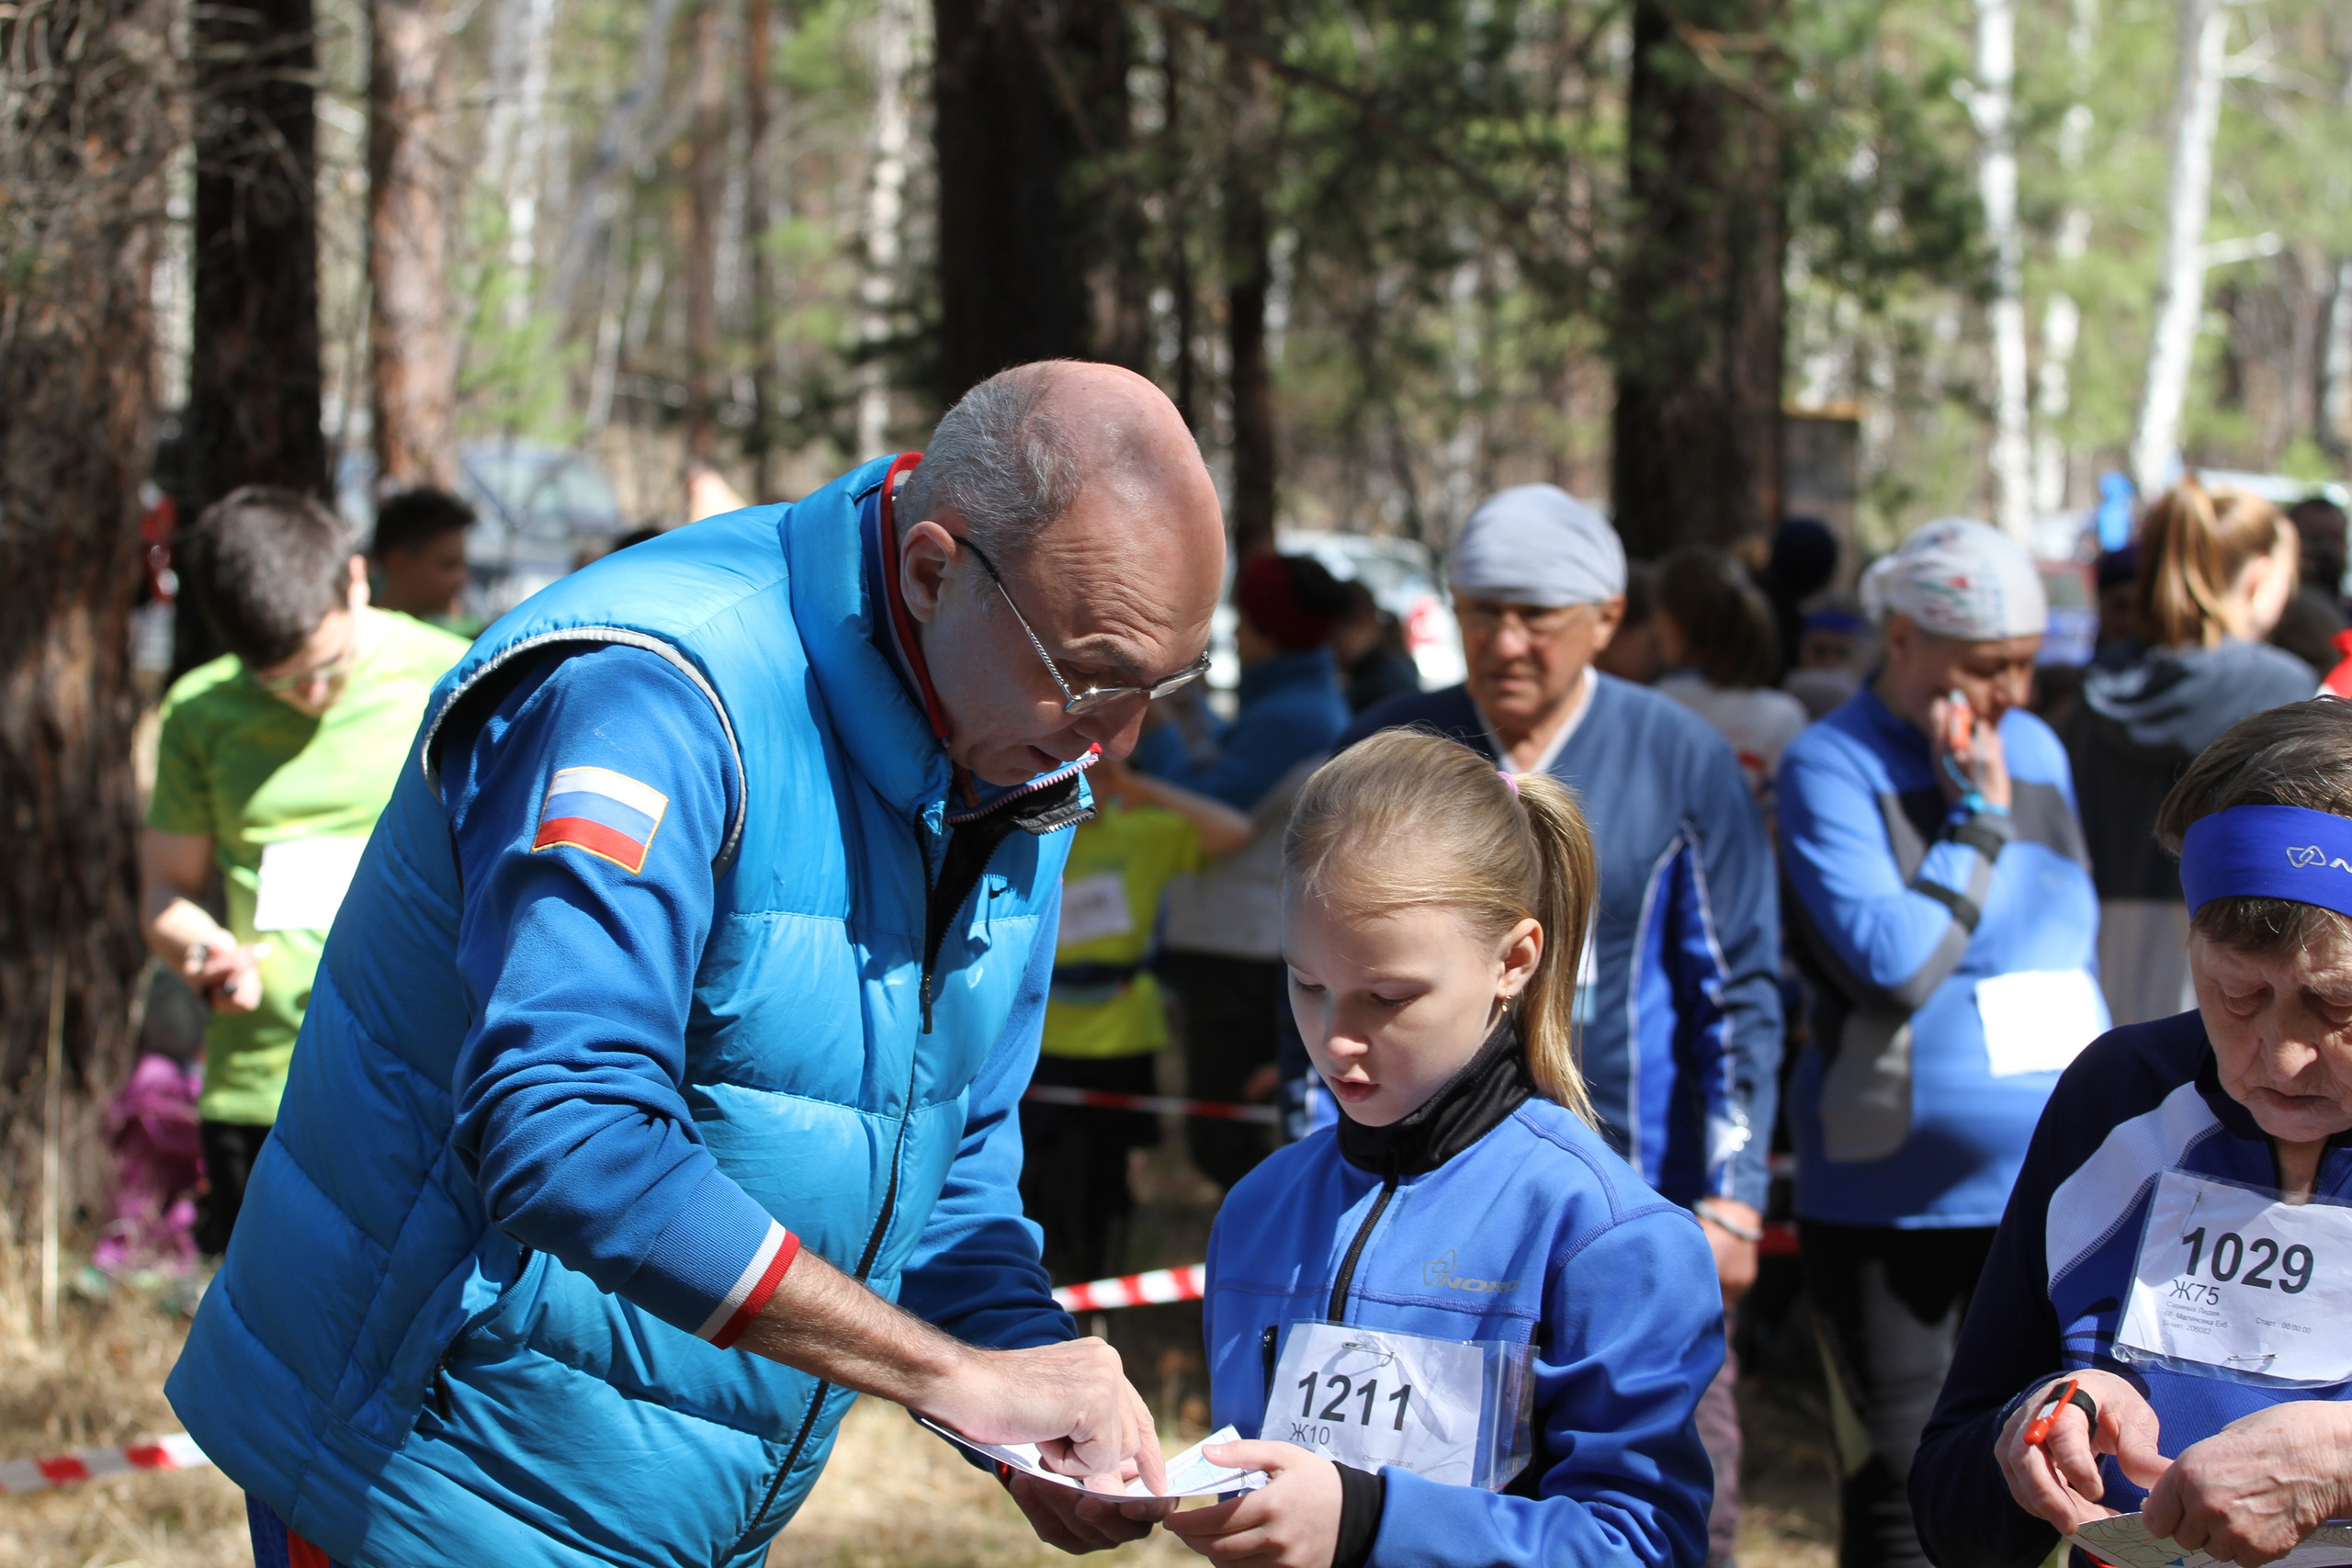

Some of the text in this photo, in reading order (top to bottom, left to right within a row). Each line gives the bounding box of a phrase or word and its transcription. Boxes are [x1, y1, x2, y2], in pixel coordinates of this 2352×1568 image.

[2182, 1226, 2314, 1294] 1029
[1436, 1277, 1521, 1294] NORD
[2168, 1279, 2220, 1305] Ж75
[2256, 1317, 2312, 1334] Старт 00:00:00
[1298, 1371, 1411, 1431] 1211
[1289, 1422, 1330, 1445] Ж10
